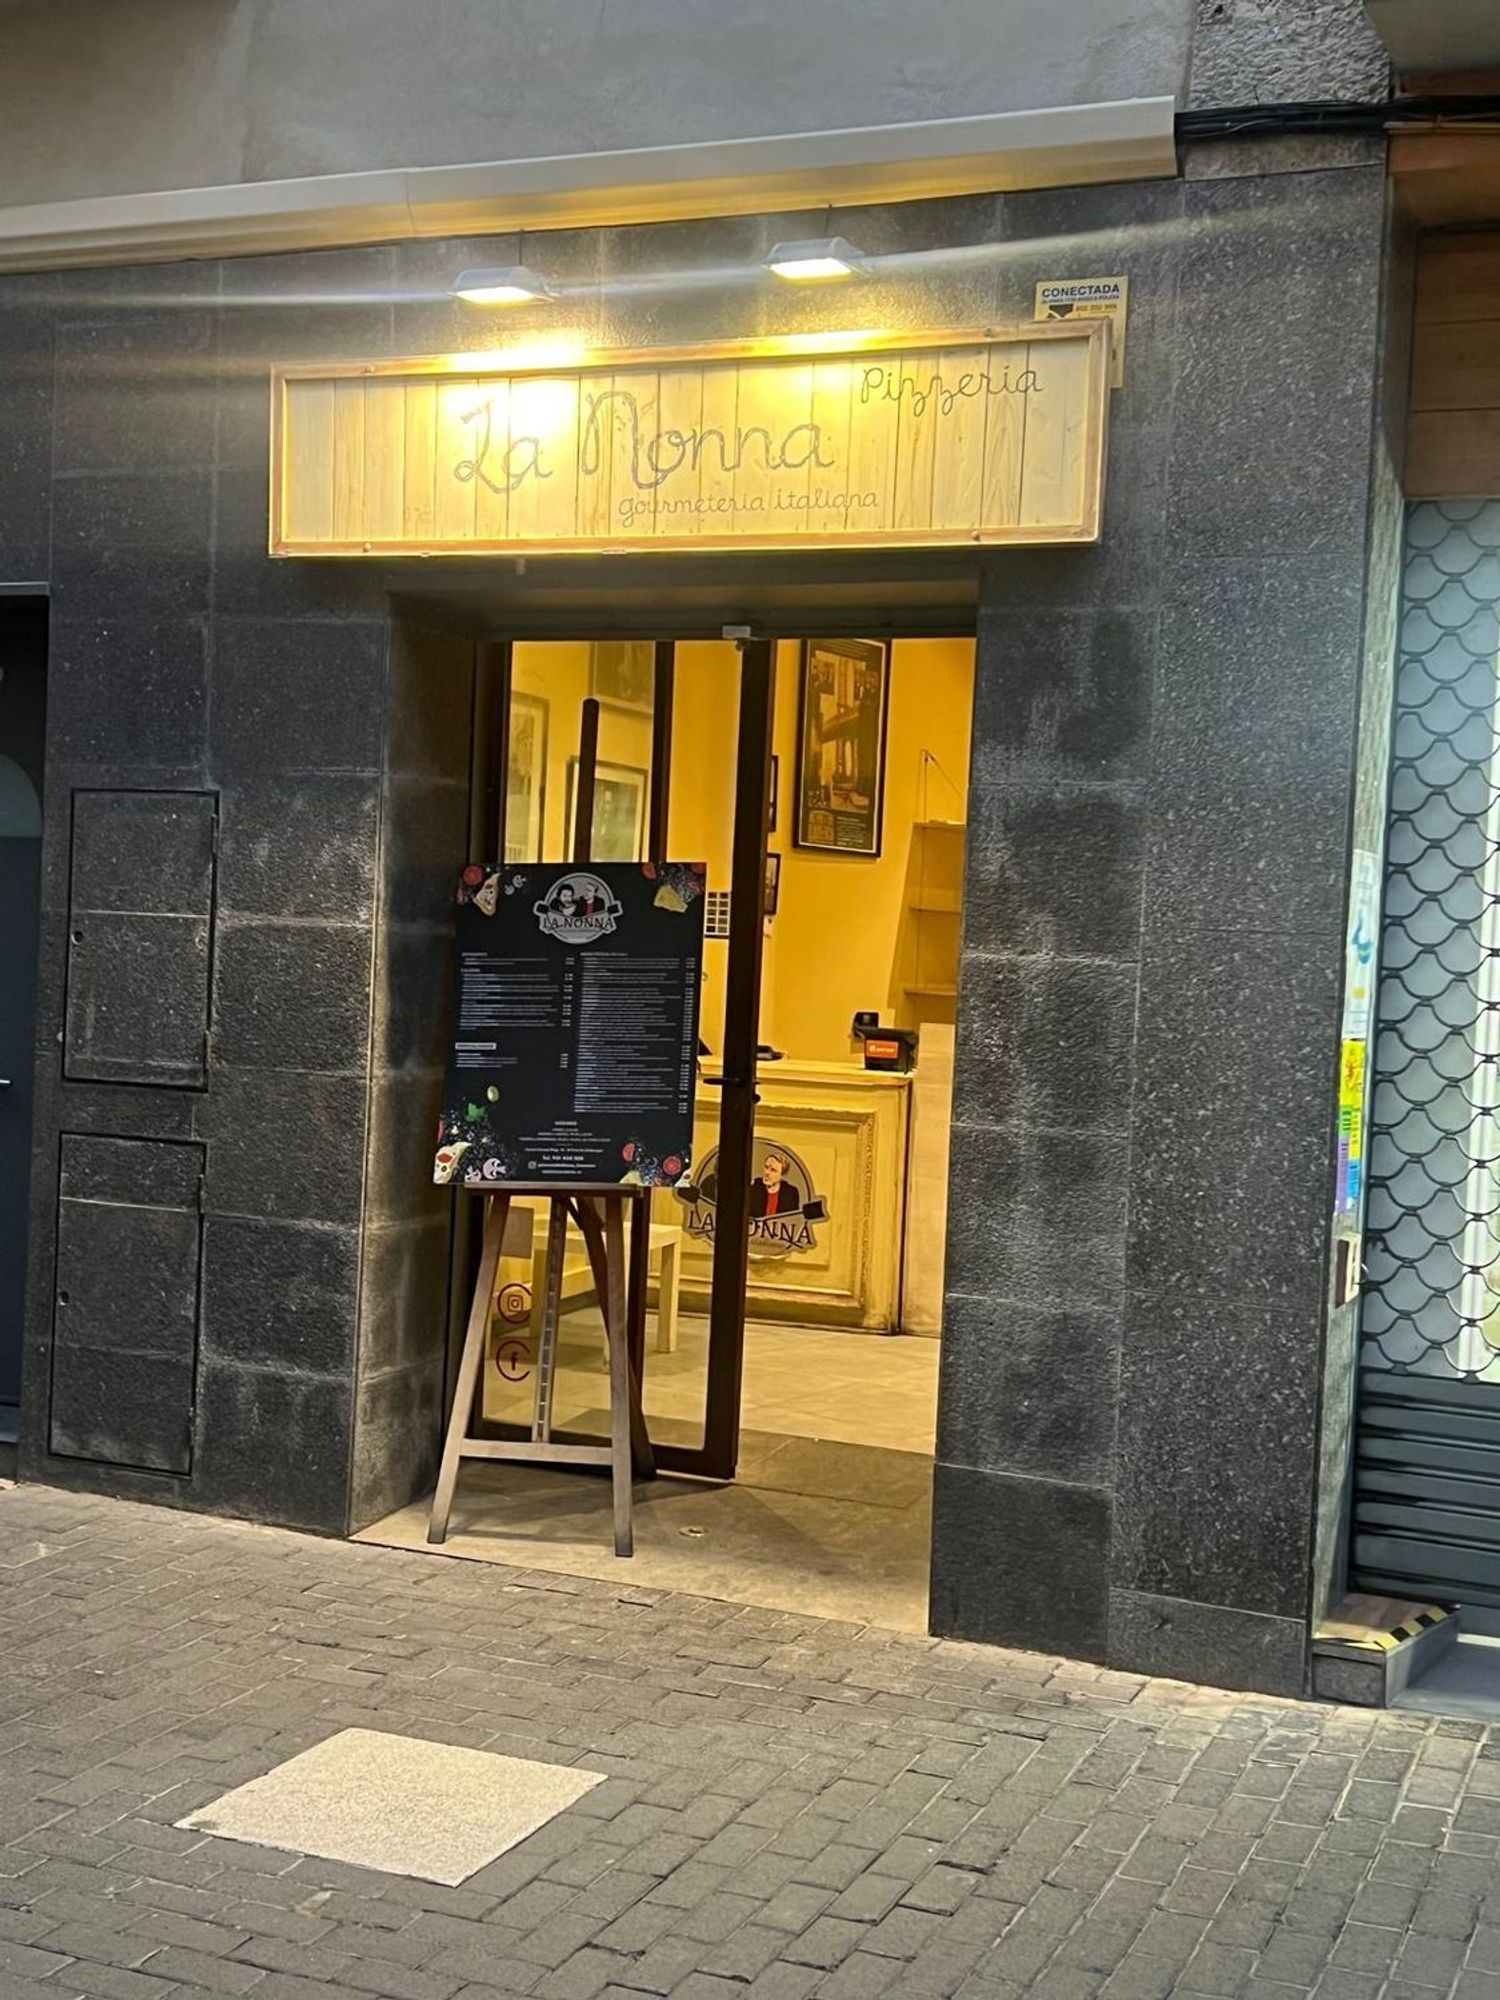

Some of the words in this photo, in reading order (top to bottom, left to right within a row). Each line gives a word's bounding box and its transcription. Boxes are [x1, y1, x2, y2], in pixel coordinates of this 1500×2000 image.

[1042, 284, 1119, 297] CONECTADA
[861, 365, 1044, 417] Pizzeria
[453, 398, 553, 494] La
[581, 391, 835, 490] Nonna
[618, 495, 765, 528] gourmeteria
[774, 487, 879, 511] italiana
[563, 917, 615, 930] NONNA
[689, 1210, 715, 1230] LA
